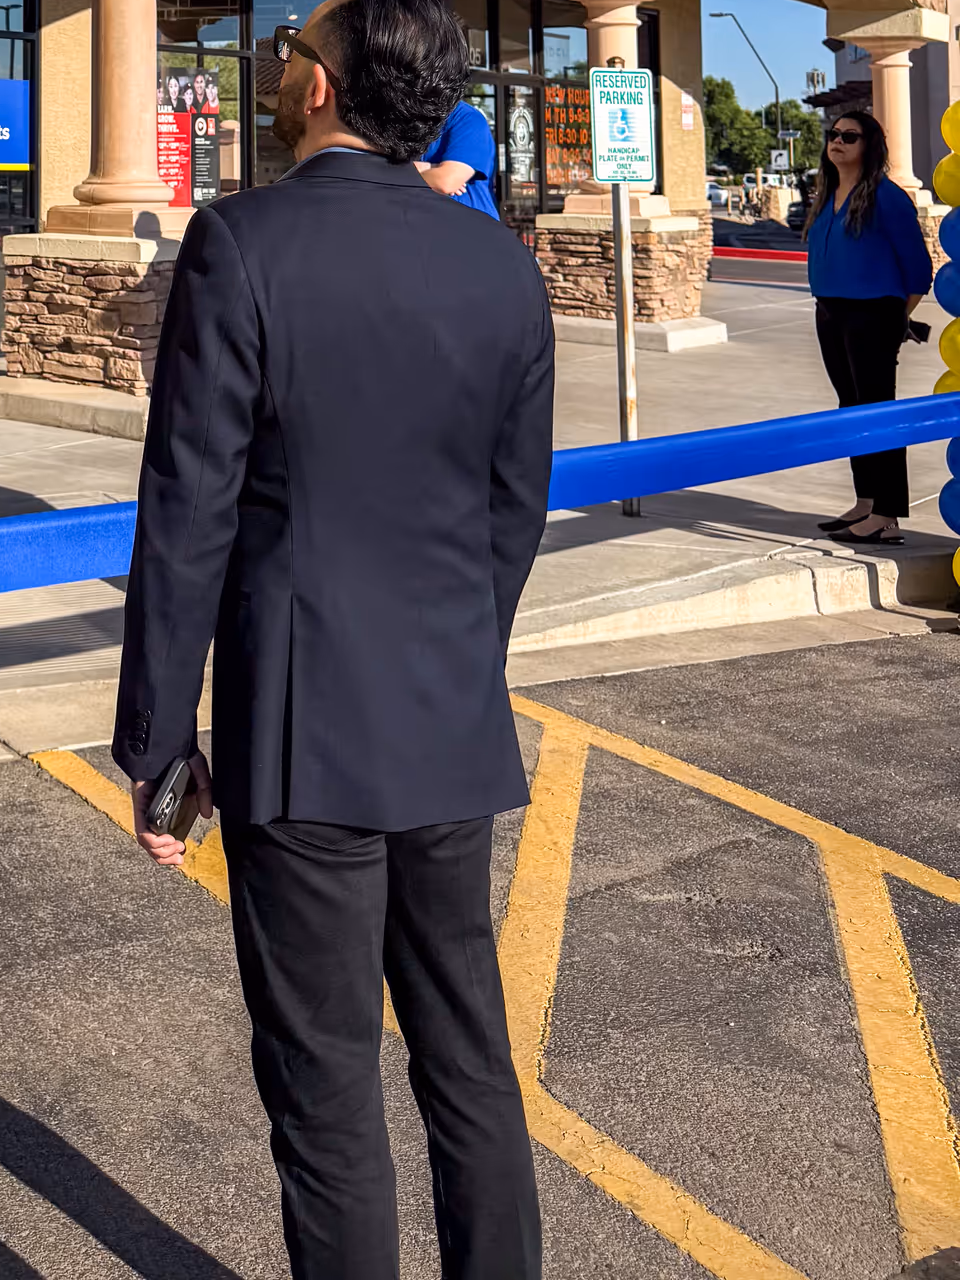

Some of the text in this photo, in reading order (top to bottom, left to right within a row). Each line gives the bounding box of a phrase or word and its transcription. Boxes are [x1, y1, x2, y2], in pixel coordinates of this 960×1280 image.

[469, 48, 481, 65] 05
[595, 75, 646, 89] RESERVED
[545, 86, 590, 106] NEW HOUR
[599, 91, 643, 105] PARKING
